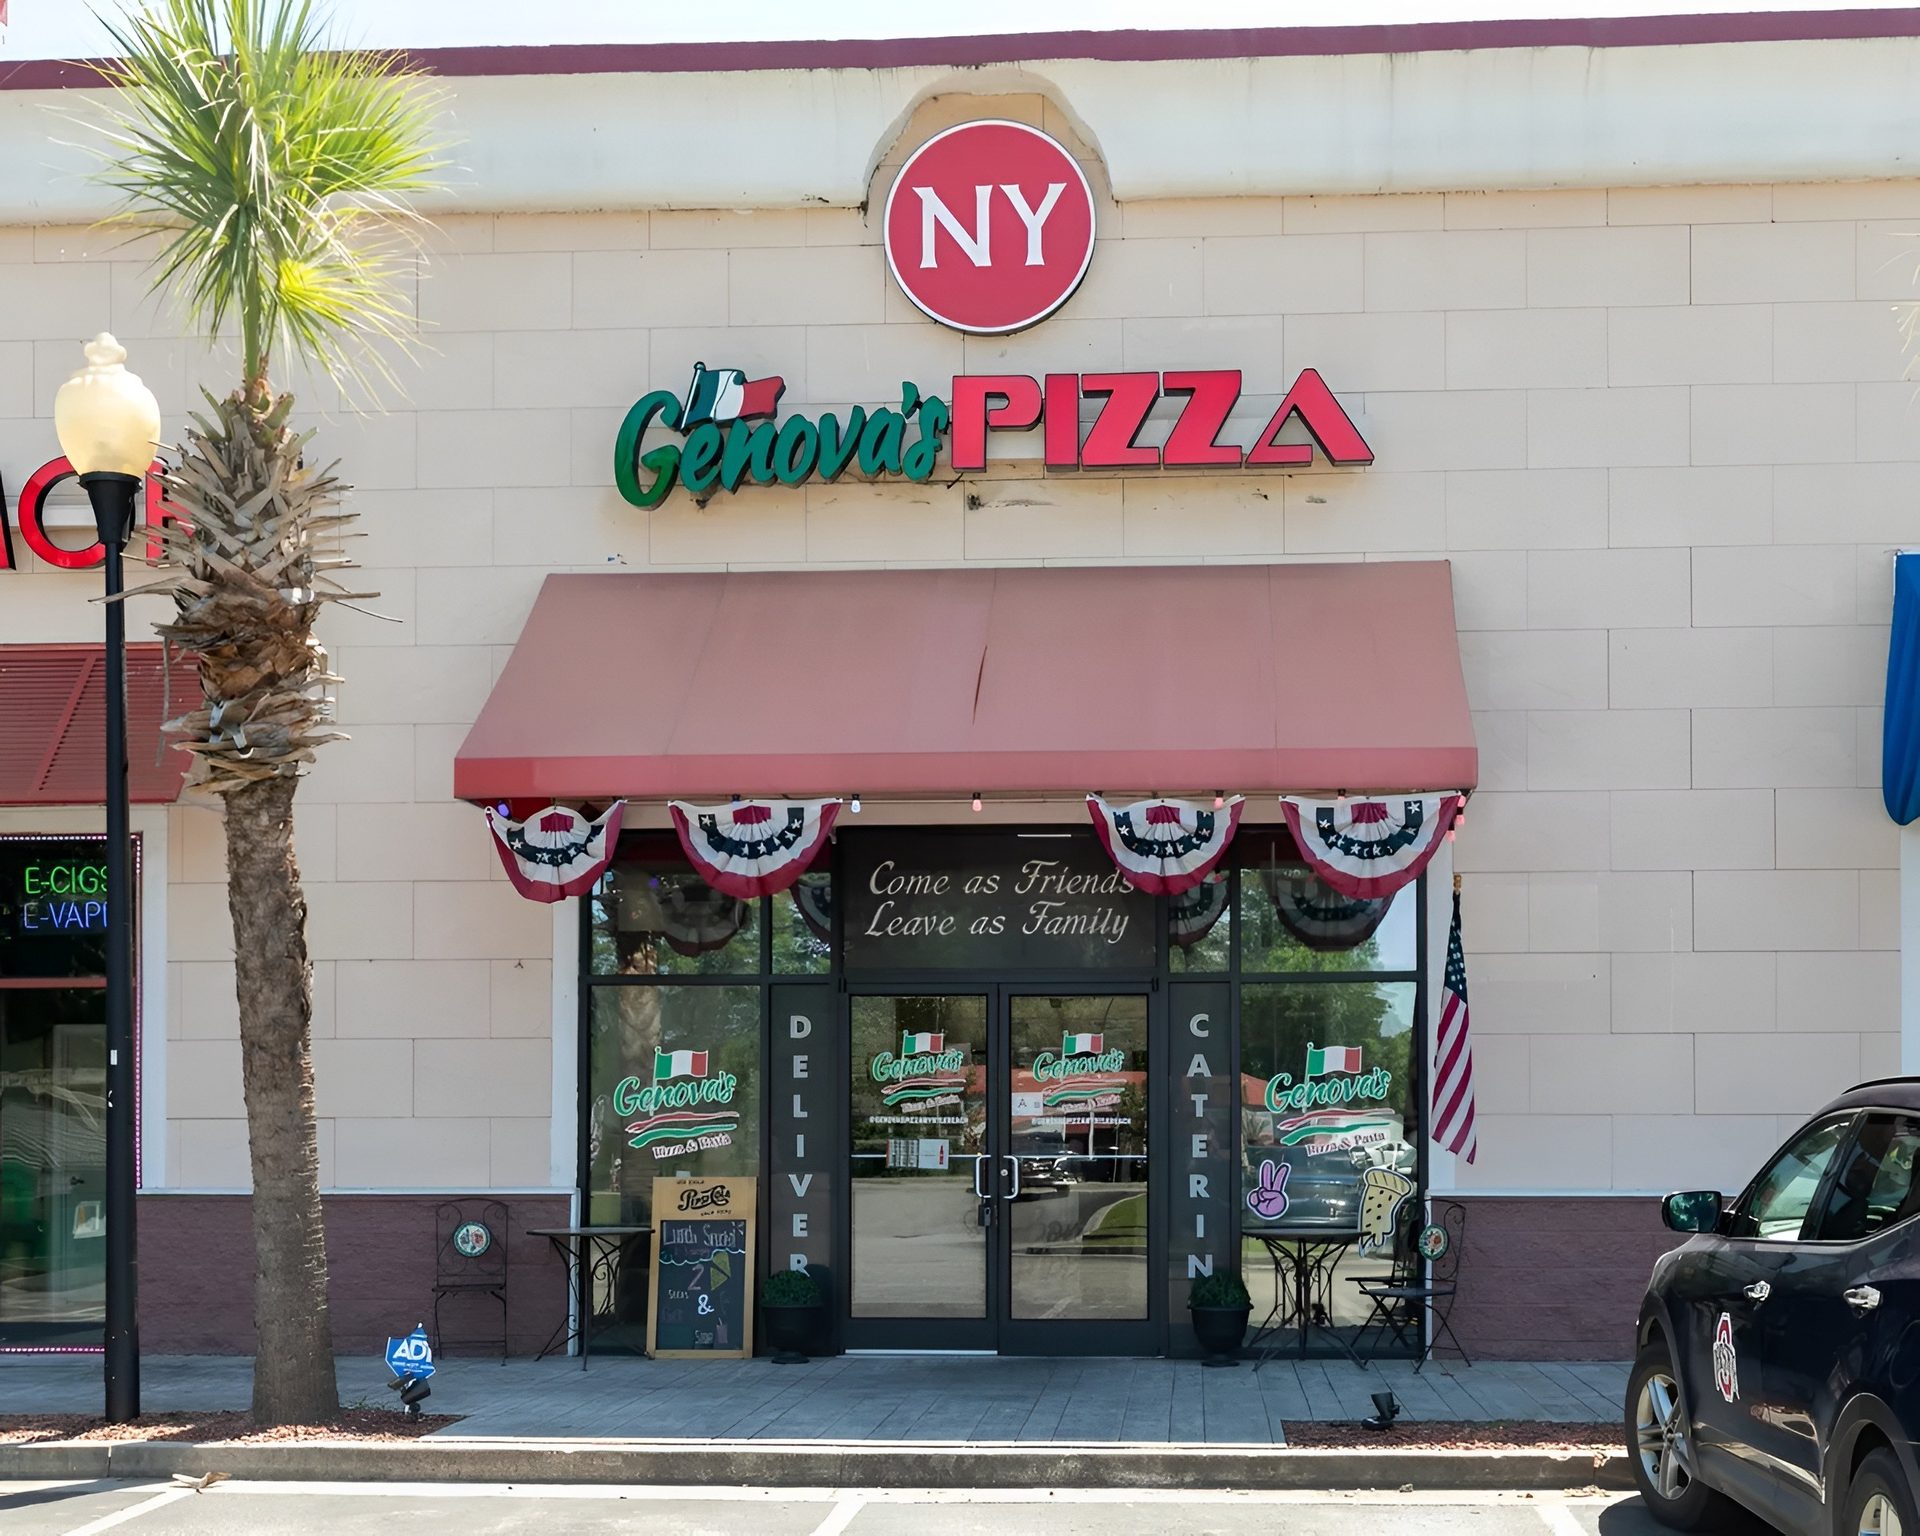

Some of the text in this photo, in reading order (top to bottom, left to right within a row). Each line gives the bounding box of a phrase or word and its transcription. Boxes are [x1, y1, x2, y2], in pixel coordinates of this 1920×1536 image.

[912, 183, 1068, 268] NY
[614, 368, 1374, 511] Genova's PIZZA
[869, 859, 1135, 895] Come as Friends
[864, 900, 1129, 944] Leave as Family
[613, 1071, 737, 1117] Genova's
[1264, 1067, 1392, 1114] Genova's
[788, 1015, 813, 1278] DELIVER
[1186, 1013, 1214, 1279] CATERIN
[688, 1264, 705, 1291] 2
[698, 1294, 714, 1315] &
